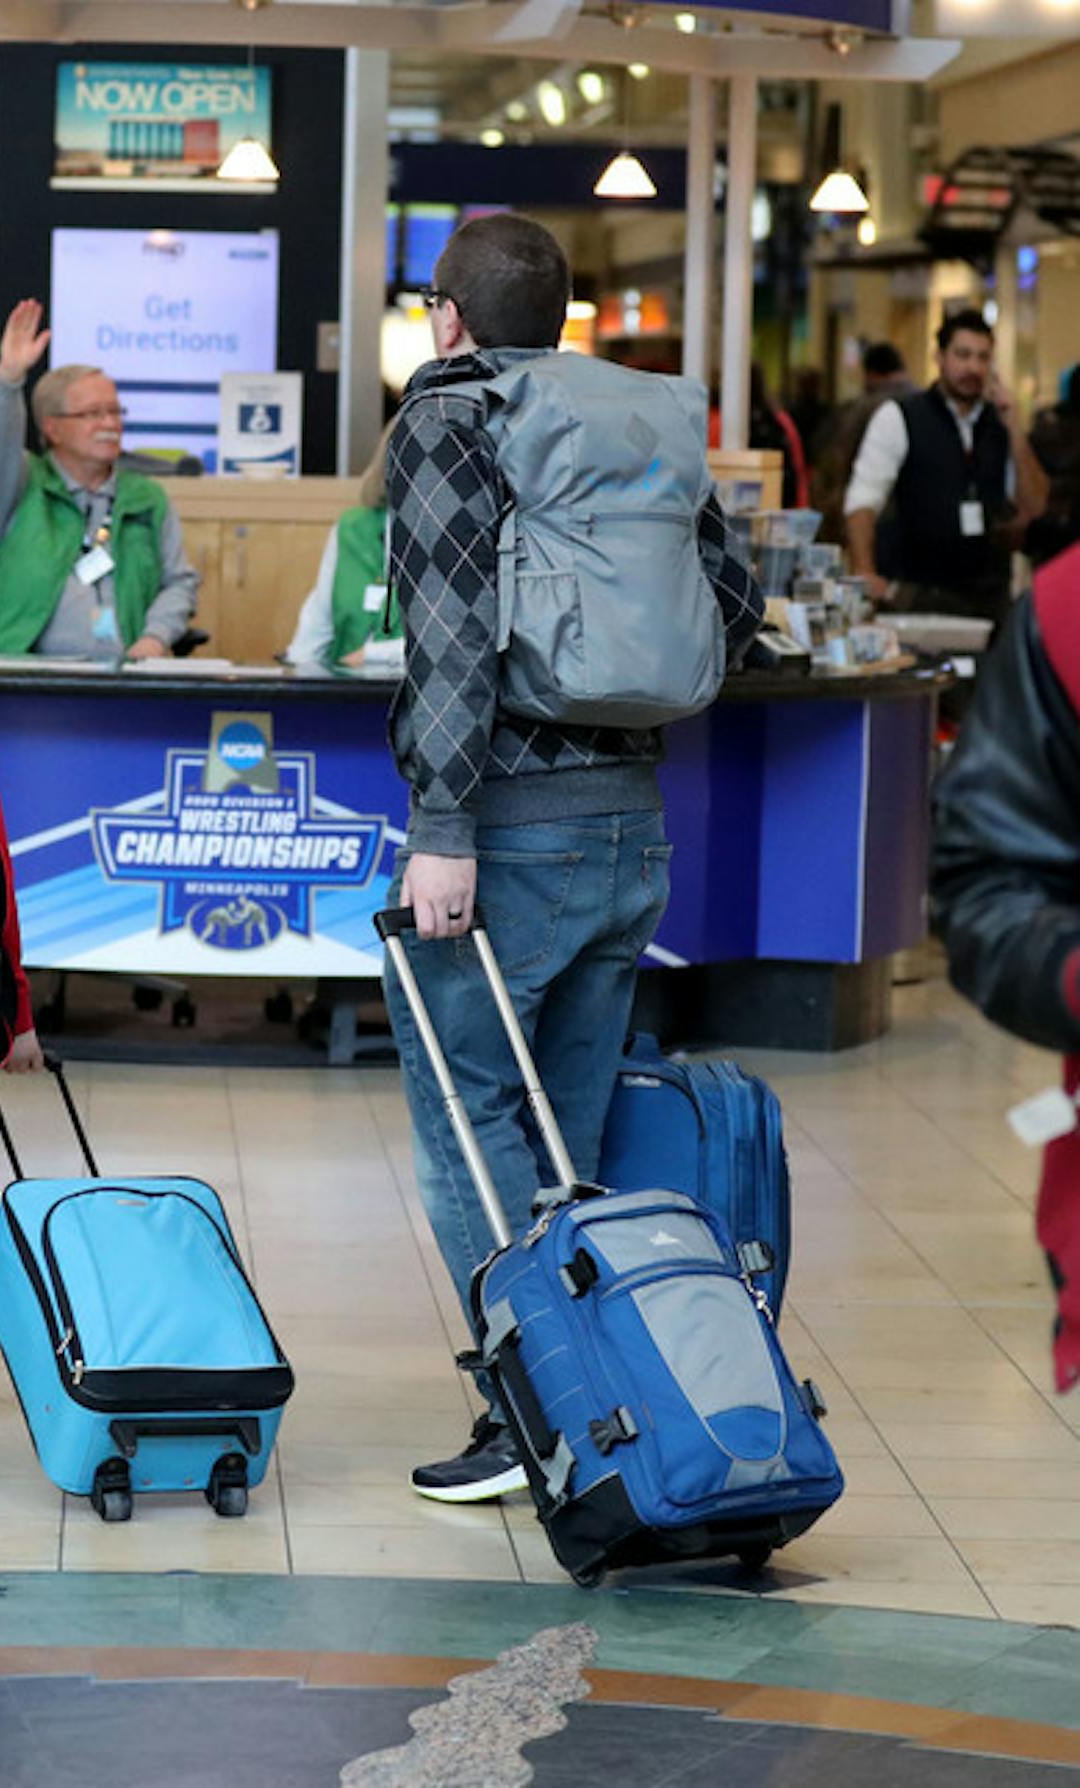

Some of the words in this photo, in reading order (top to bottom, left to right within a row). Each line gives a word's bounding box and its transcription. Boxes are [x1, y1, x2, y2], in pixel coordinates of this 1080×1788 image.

[75, 81, 157, 112] NOW
[160, 80, 256, 114] OPEN
[144, 295, 192, 320] Get
[96, 324, 238, 353] Directions
[221, 743, 265, 758] NCAA
[222, 797, 284, 809] DIVISION
[180, 809, 297, 834] WRESTLING
[116, 832, 360, 869] CHAMPIONSHIPS
[184, 881, 289, 897] MINNEAPOLIS
